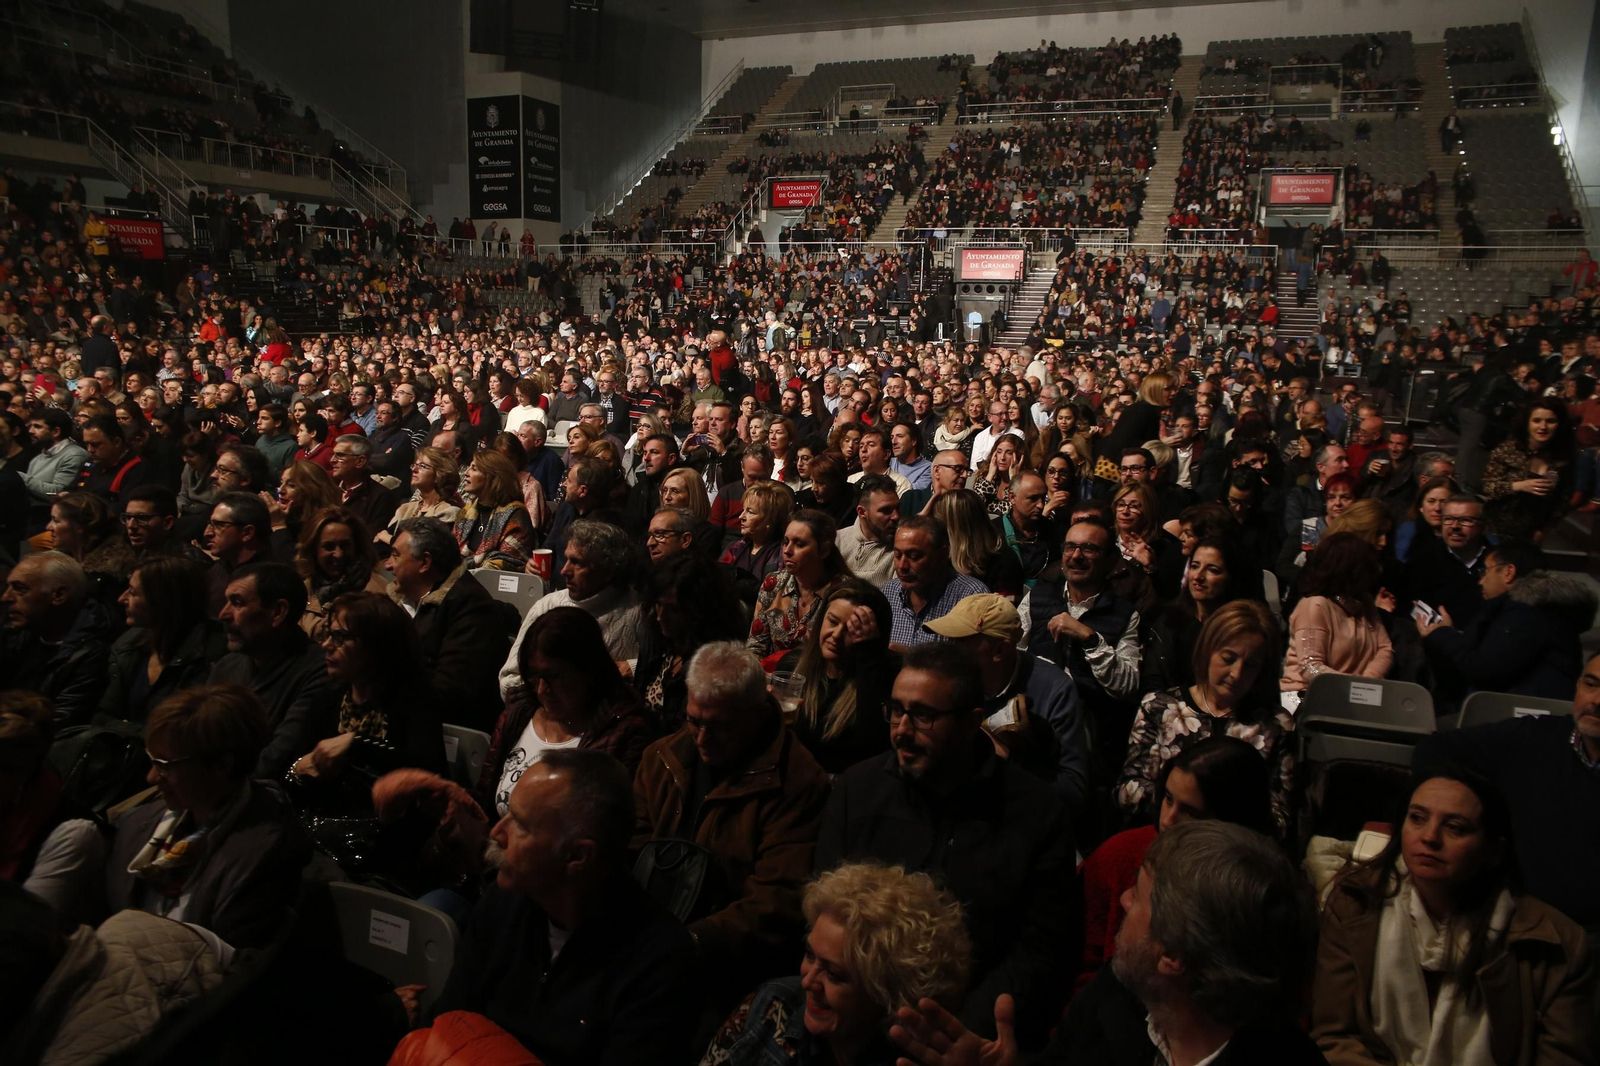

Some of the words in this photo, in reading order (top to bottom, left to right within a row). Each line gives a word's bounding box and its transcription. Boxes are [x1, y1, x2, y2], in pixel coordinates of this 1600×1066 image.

[471, 129, 518, 138] AYUNTAMIENTO
[525, 128, 558, 143] AYUNTAMIENTO
[484, 138, 514, 146] GRANADA
[534, 139, 556, 152] GRANADA
[109, 224, 158, 234] NTAMIENTO
[120, 237, 154, 246] RANADA
